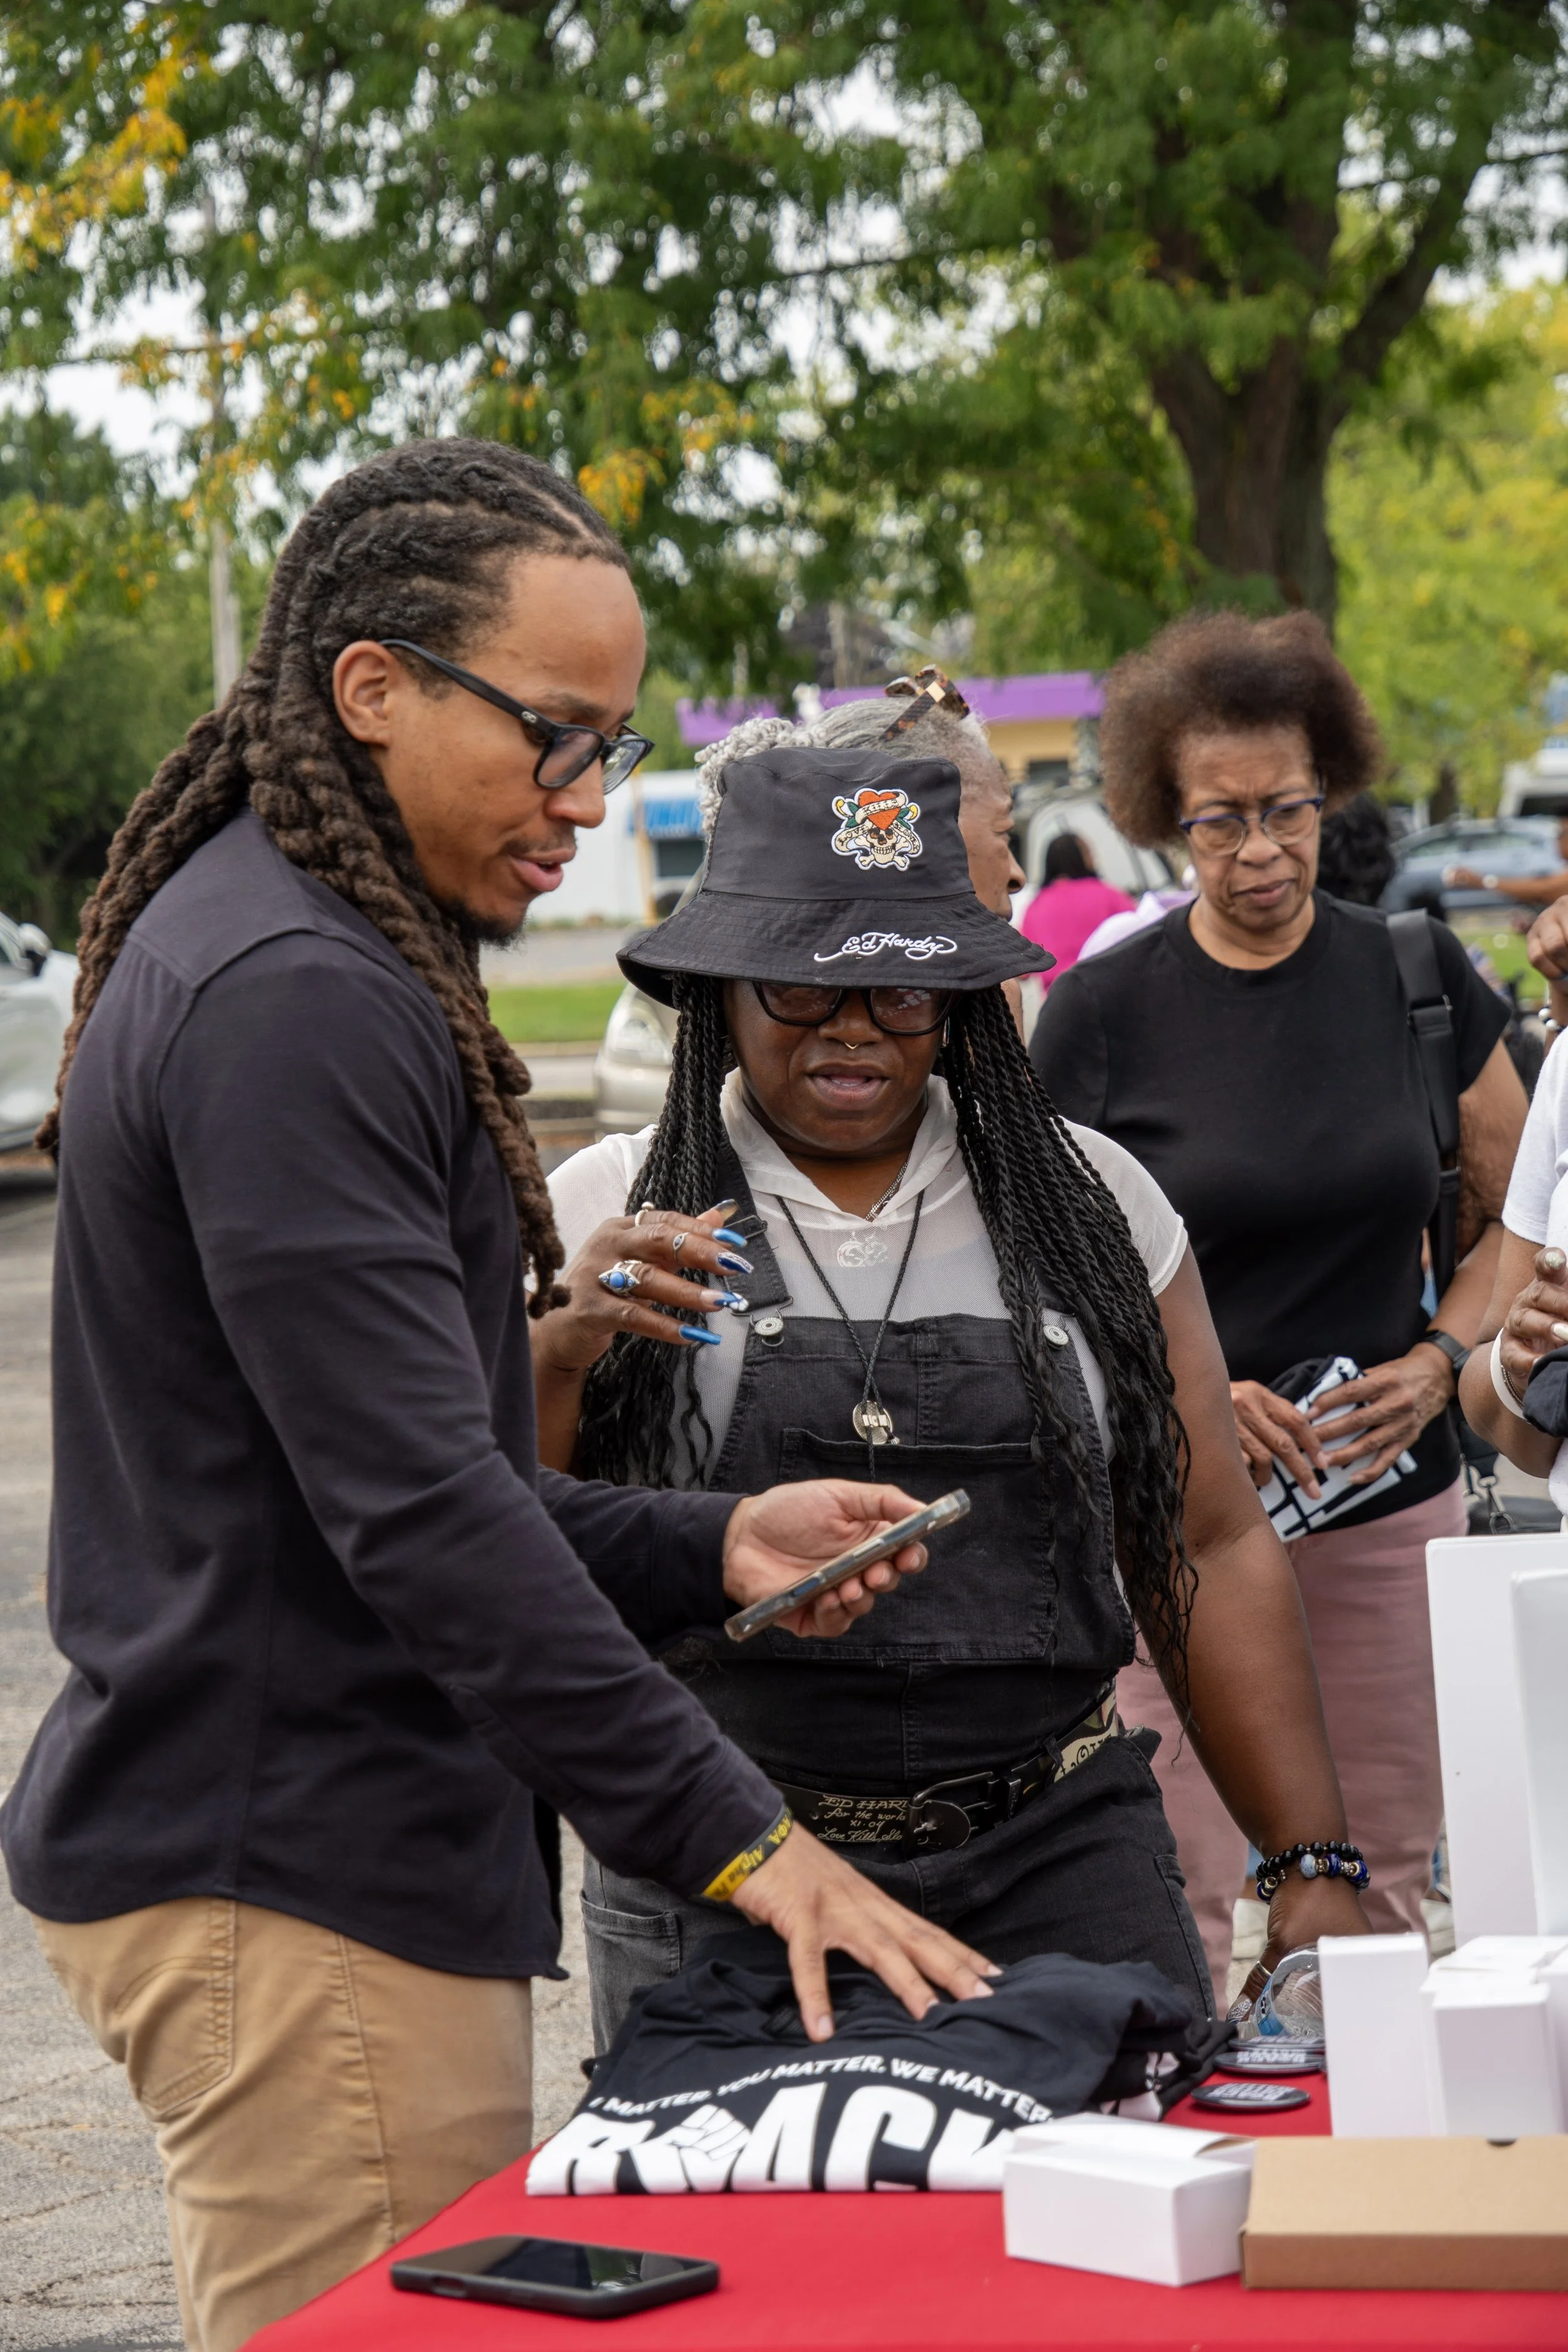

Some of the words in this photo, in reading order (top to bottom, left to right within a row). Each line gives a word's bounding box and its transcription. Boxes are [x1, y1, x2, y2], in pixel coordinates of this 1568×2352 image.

[838, 824, 869, 846] LOVE
[858, 932, 957, 960] Hardy
[818, 1794, 853, 1807] ED
[824, 1808, 850, 1818] for
[855, 1811, 872, 1819] the
[817, 1826, 845, 1840] Love
[588, 2097, 605, 2109] I
[717, 2068, 771, 2097] YOU
[771, 2055, 887, 2079] MATTER.
[891, 2058, 940, 2082] WE
